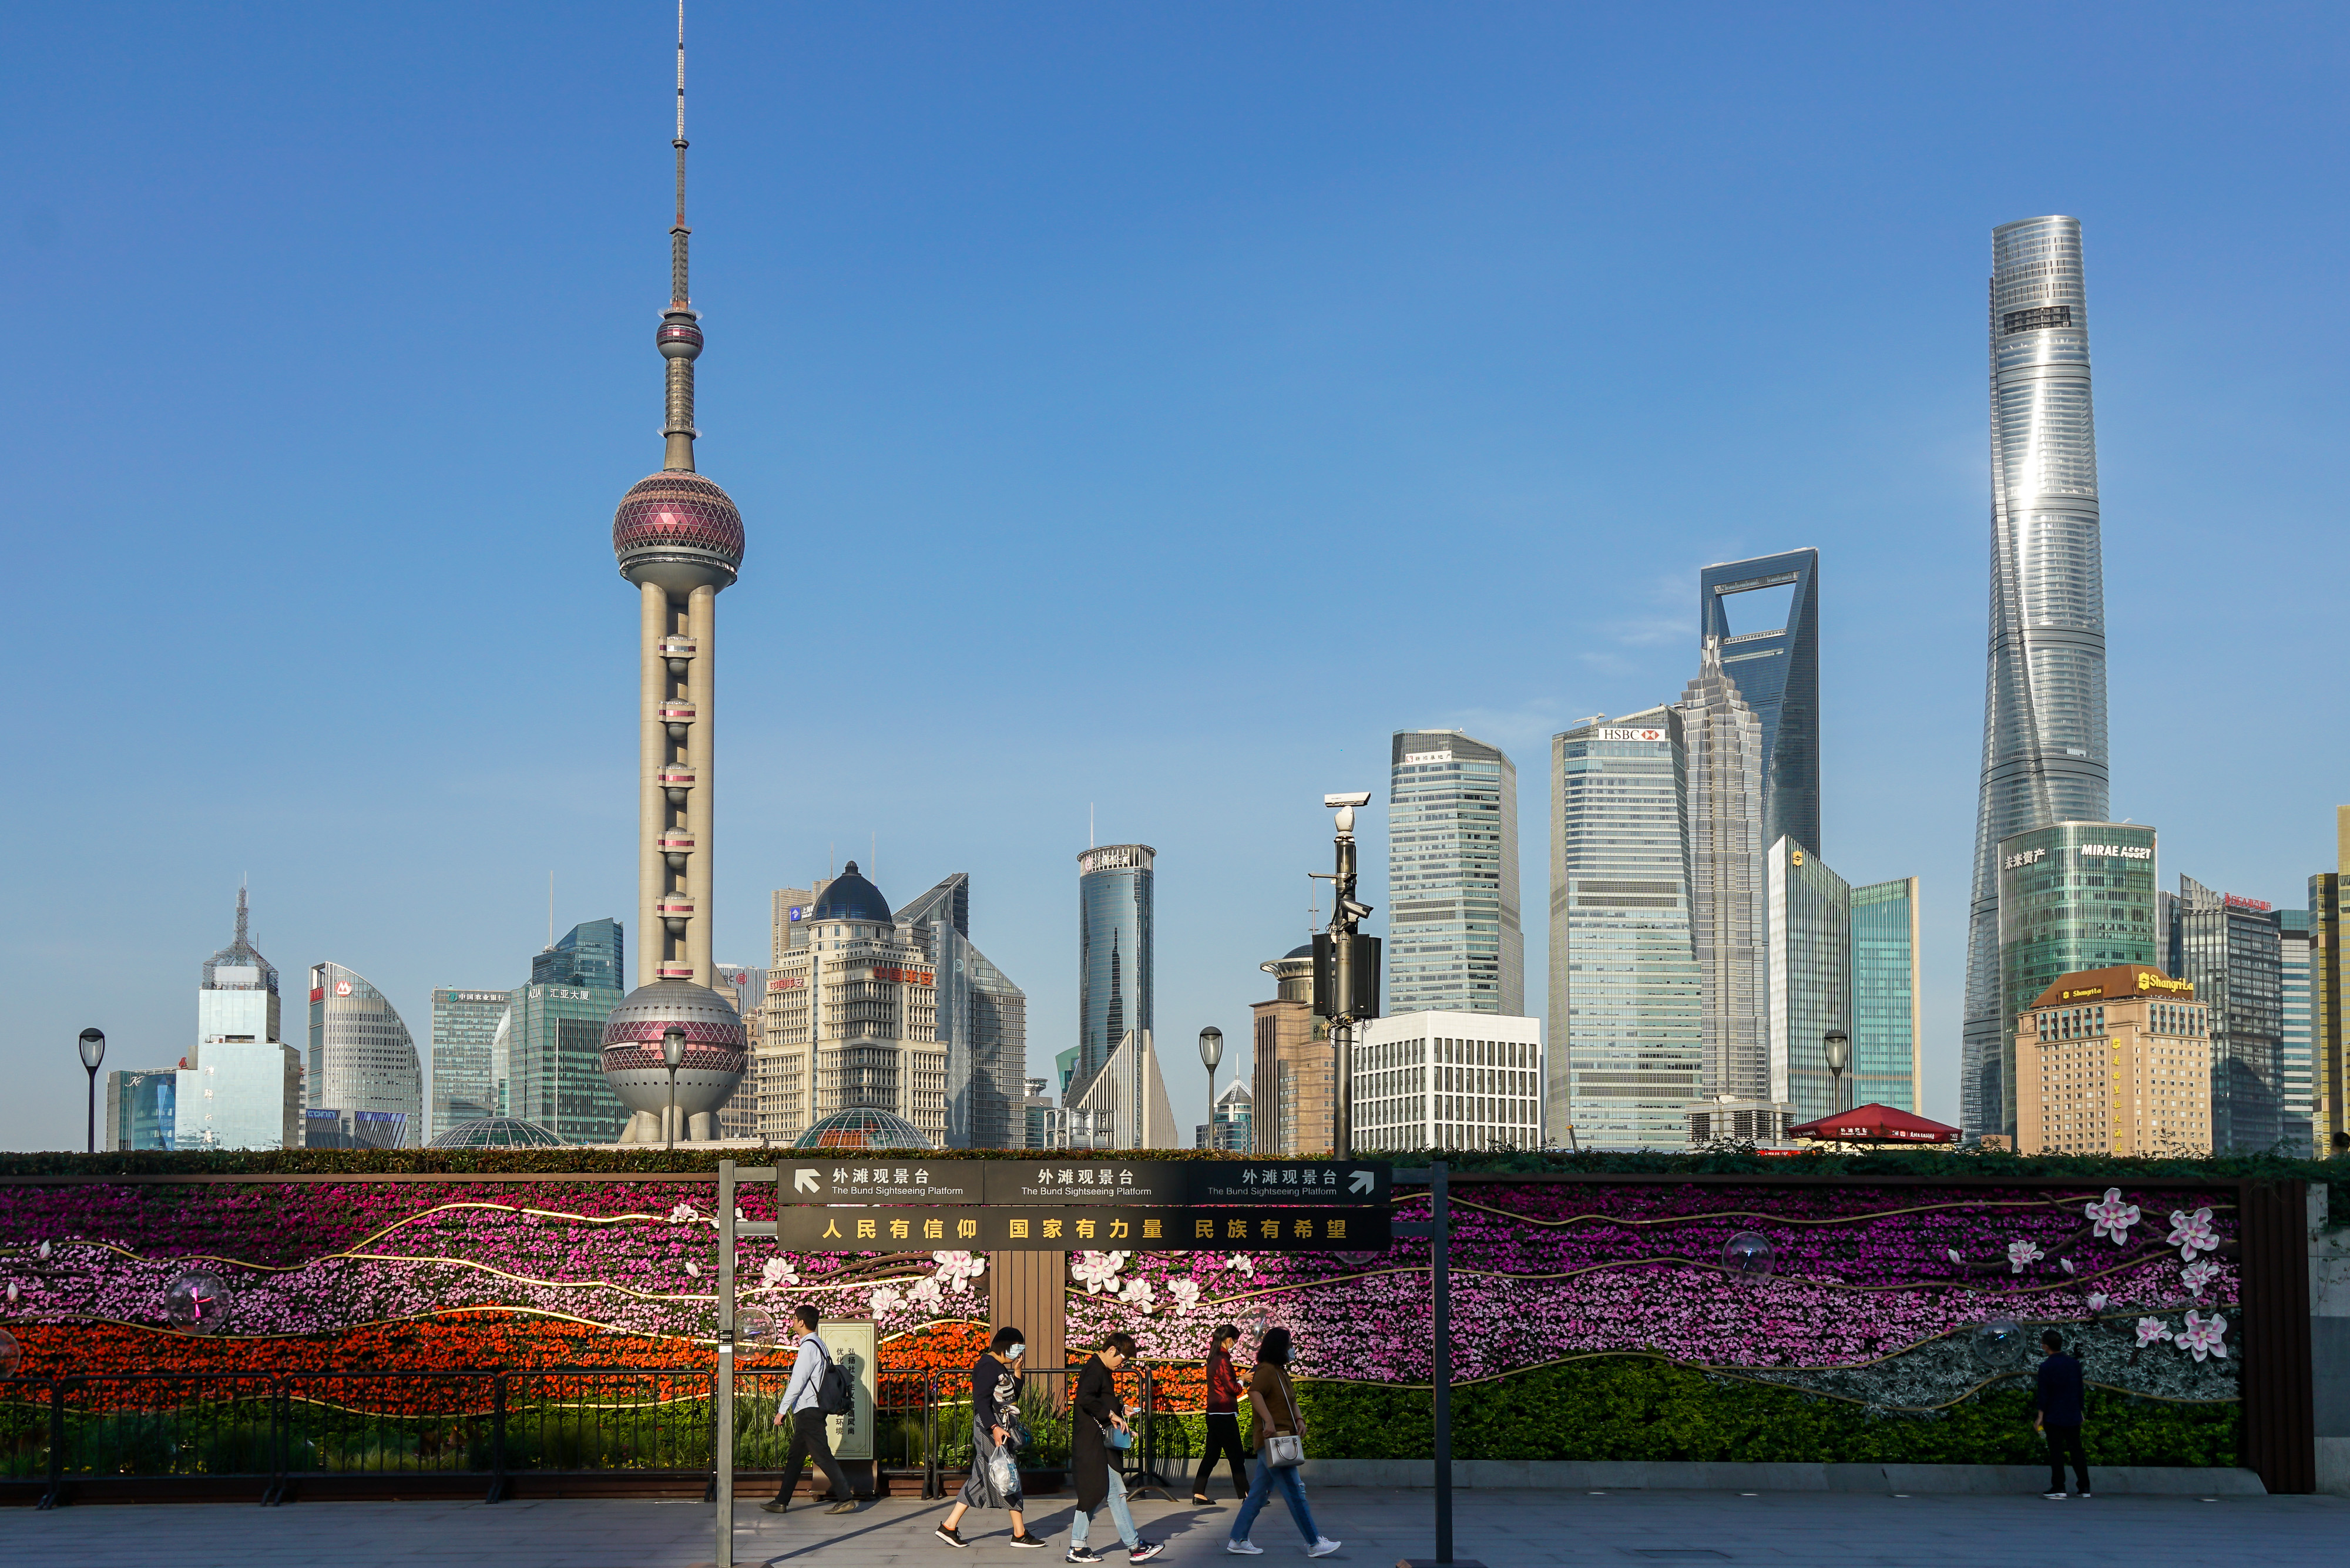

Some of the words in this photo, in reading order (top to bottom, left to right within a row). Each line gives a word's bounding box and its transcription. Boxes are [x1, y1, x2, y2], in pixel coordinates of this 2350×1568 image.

[1604, 729, 1639, 740] HSBC
[2005, 848, 2045, 870] 未来资产
[2081, 844, 2119, 857] MIRAE
[2120, 846, 2151, 859] ASSET
[770, 976, 804, 991] 中国平安
[873, 965, 933, 986] 中国平安
[459, 993, 505, 1002] 中国农业银行
[528, 989, 541, 999] AZIA
[550, 988, 589, 1000] 汇亚大厦
[2112, 1055, 2123, 1152] 香格里拉大酒店
[832, 1167, 929, 1184] 外滩观景台
[1038, 1169, 1133, 1185] 外滩观景台
[1242, 1169, 1337, 1185] 外滩观景台
[832, 1186, 848, 1194] The
[851, 1186, 873, 1194] Bund
[875, 1186, 925, 1196] Sightseeing
[928, 1186, 963, 1194] Platform
[1021, 1187, 1038, 1195] The
[1040, 1187, 1062, 1195] Bund
[1065, 1187, 1114, 1197] Sightseeing
[1117, 1187, 1152, 1195] Platform
[1208, 1187, 1224, 1195] The
[1226, 1187, 1248, 1195] Bund
[1251, 1187, 1300, 1197] Sightseeing
[1302, 1187, 1337, 1195] Platform
[822, 1218, 977, 1239] 人民有信仰
[1009, 1218, 1163, 1238] 国家有力量
[1195, 1219, 1347, 1239] 民族有希望
[836, 1348, 844, 1364] 优化
